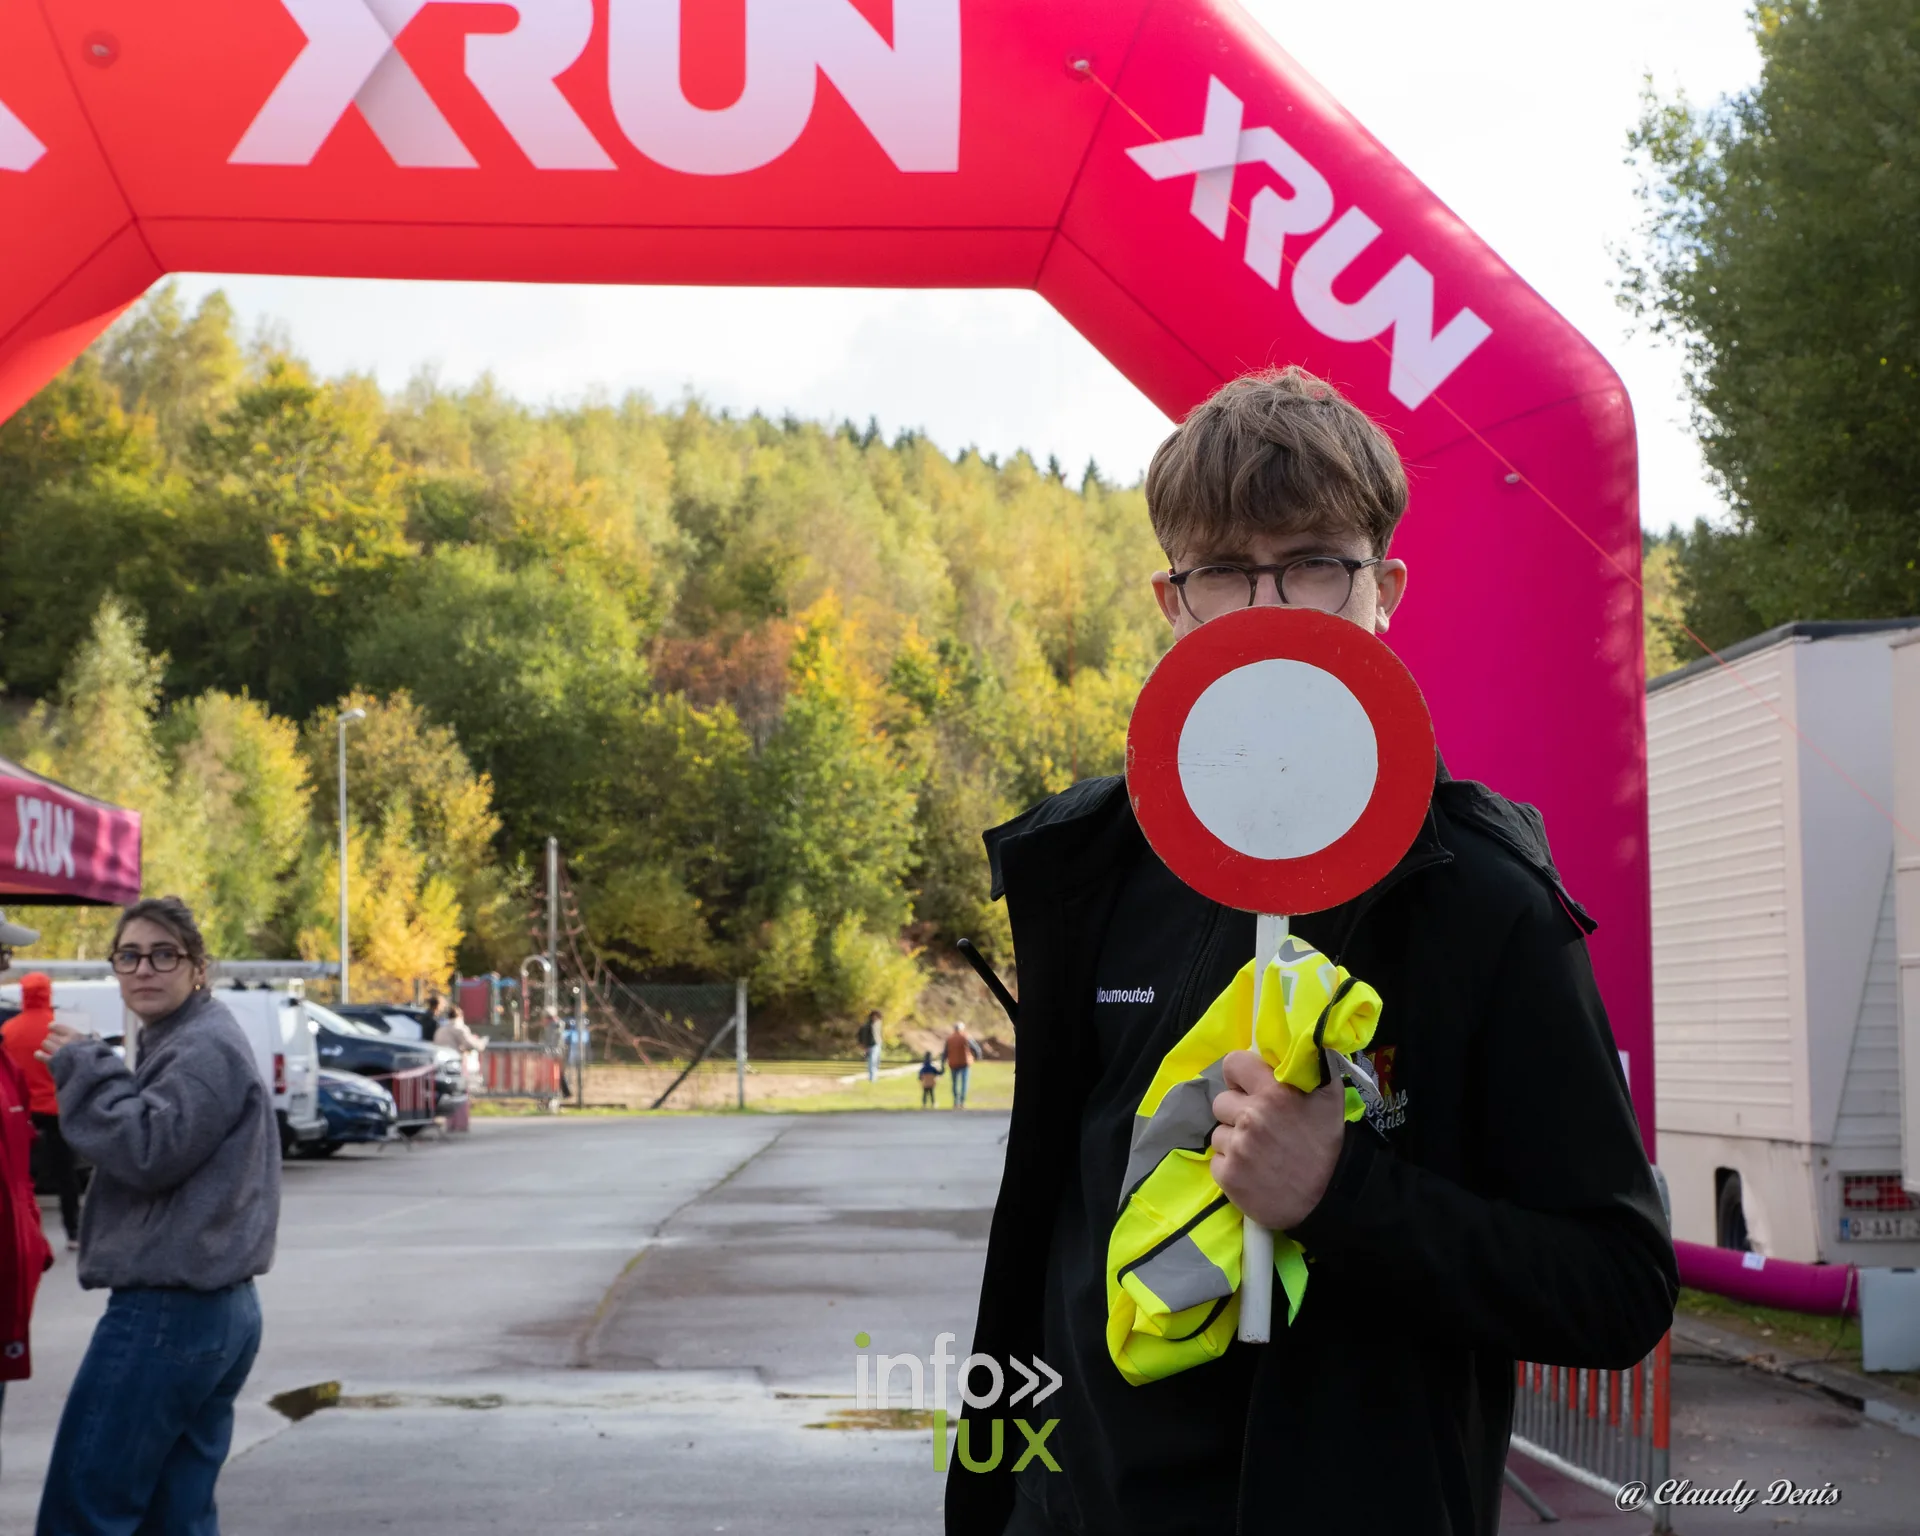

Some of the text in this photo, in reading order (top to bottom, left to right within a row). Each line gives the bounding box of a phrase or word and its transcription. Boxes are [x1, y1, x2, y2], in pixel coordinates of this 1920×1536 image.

[226, 0, 961, 176] XRUN
[1124, 73, 1494, 412] XRUN
[15, 794, 76, 879] XRUN
